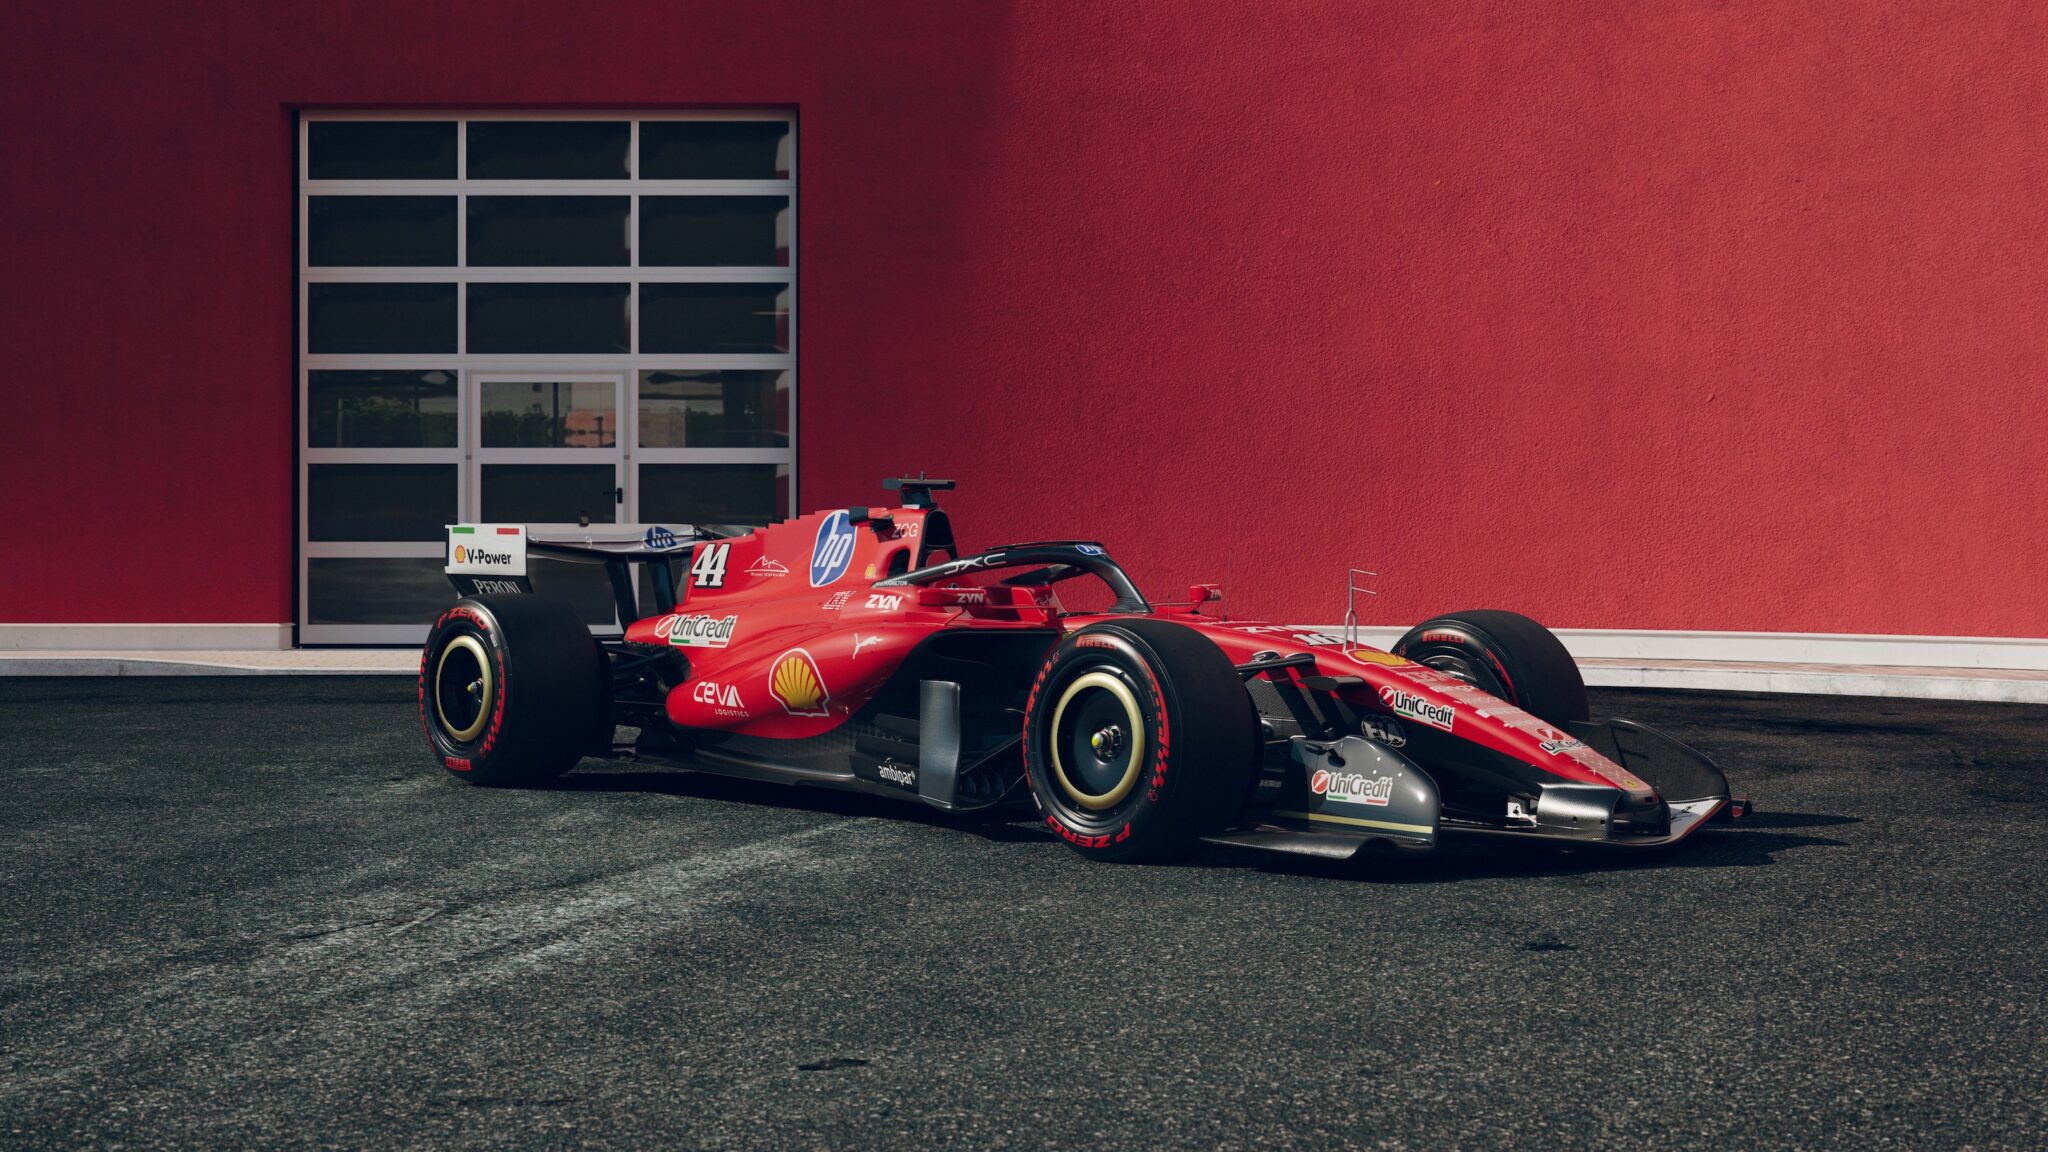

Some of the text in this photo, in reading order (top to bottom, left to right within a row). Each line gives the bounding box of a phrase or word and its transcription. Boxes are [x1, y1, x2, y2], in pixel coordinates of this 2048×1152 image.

[892, 523, 918, 537] ZCG
[813, 511, 853, 586] hp
[467, 549, 511, 565] V-Power
[691, 543, 731, 587] 44
[472, 579, 521, 594] PERONI
[864, 594, 903, 610] ZYN
[957, 593, 984, 603] ZYN
[448, 607, 488, 631] ZERO
[672, 616, 736, 639] UniCredit
[1076, 634, 1120, 650] PIRELLI
[1423, 631, 1466, 643] PIRELLI
[714, 708, 749, 717] LOGISTICS
[1395, 691, 1454, 726] UniCredit
[1329, 773, 1392, 798] UniCredit
[1046, 815, 1131, 848] P ZERO
